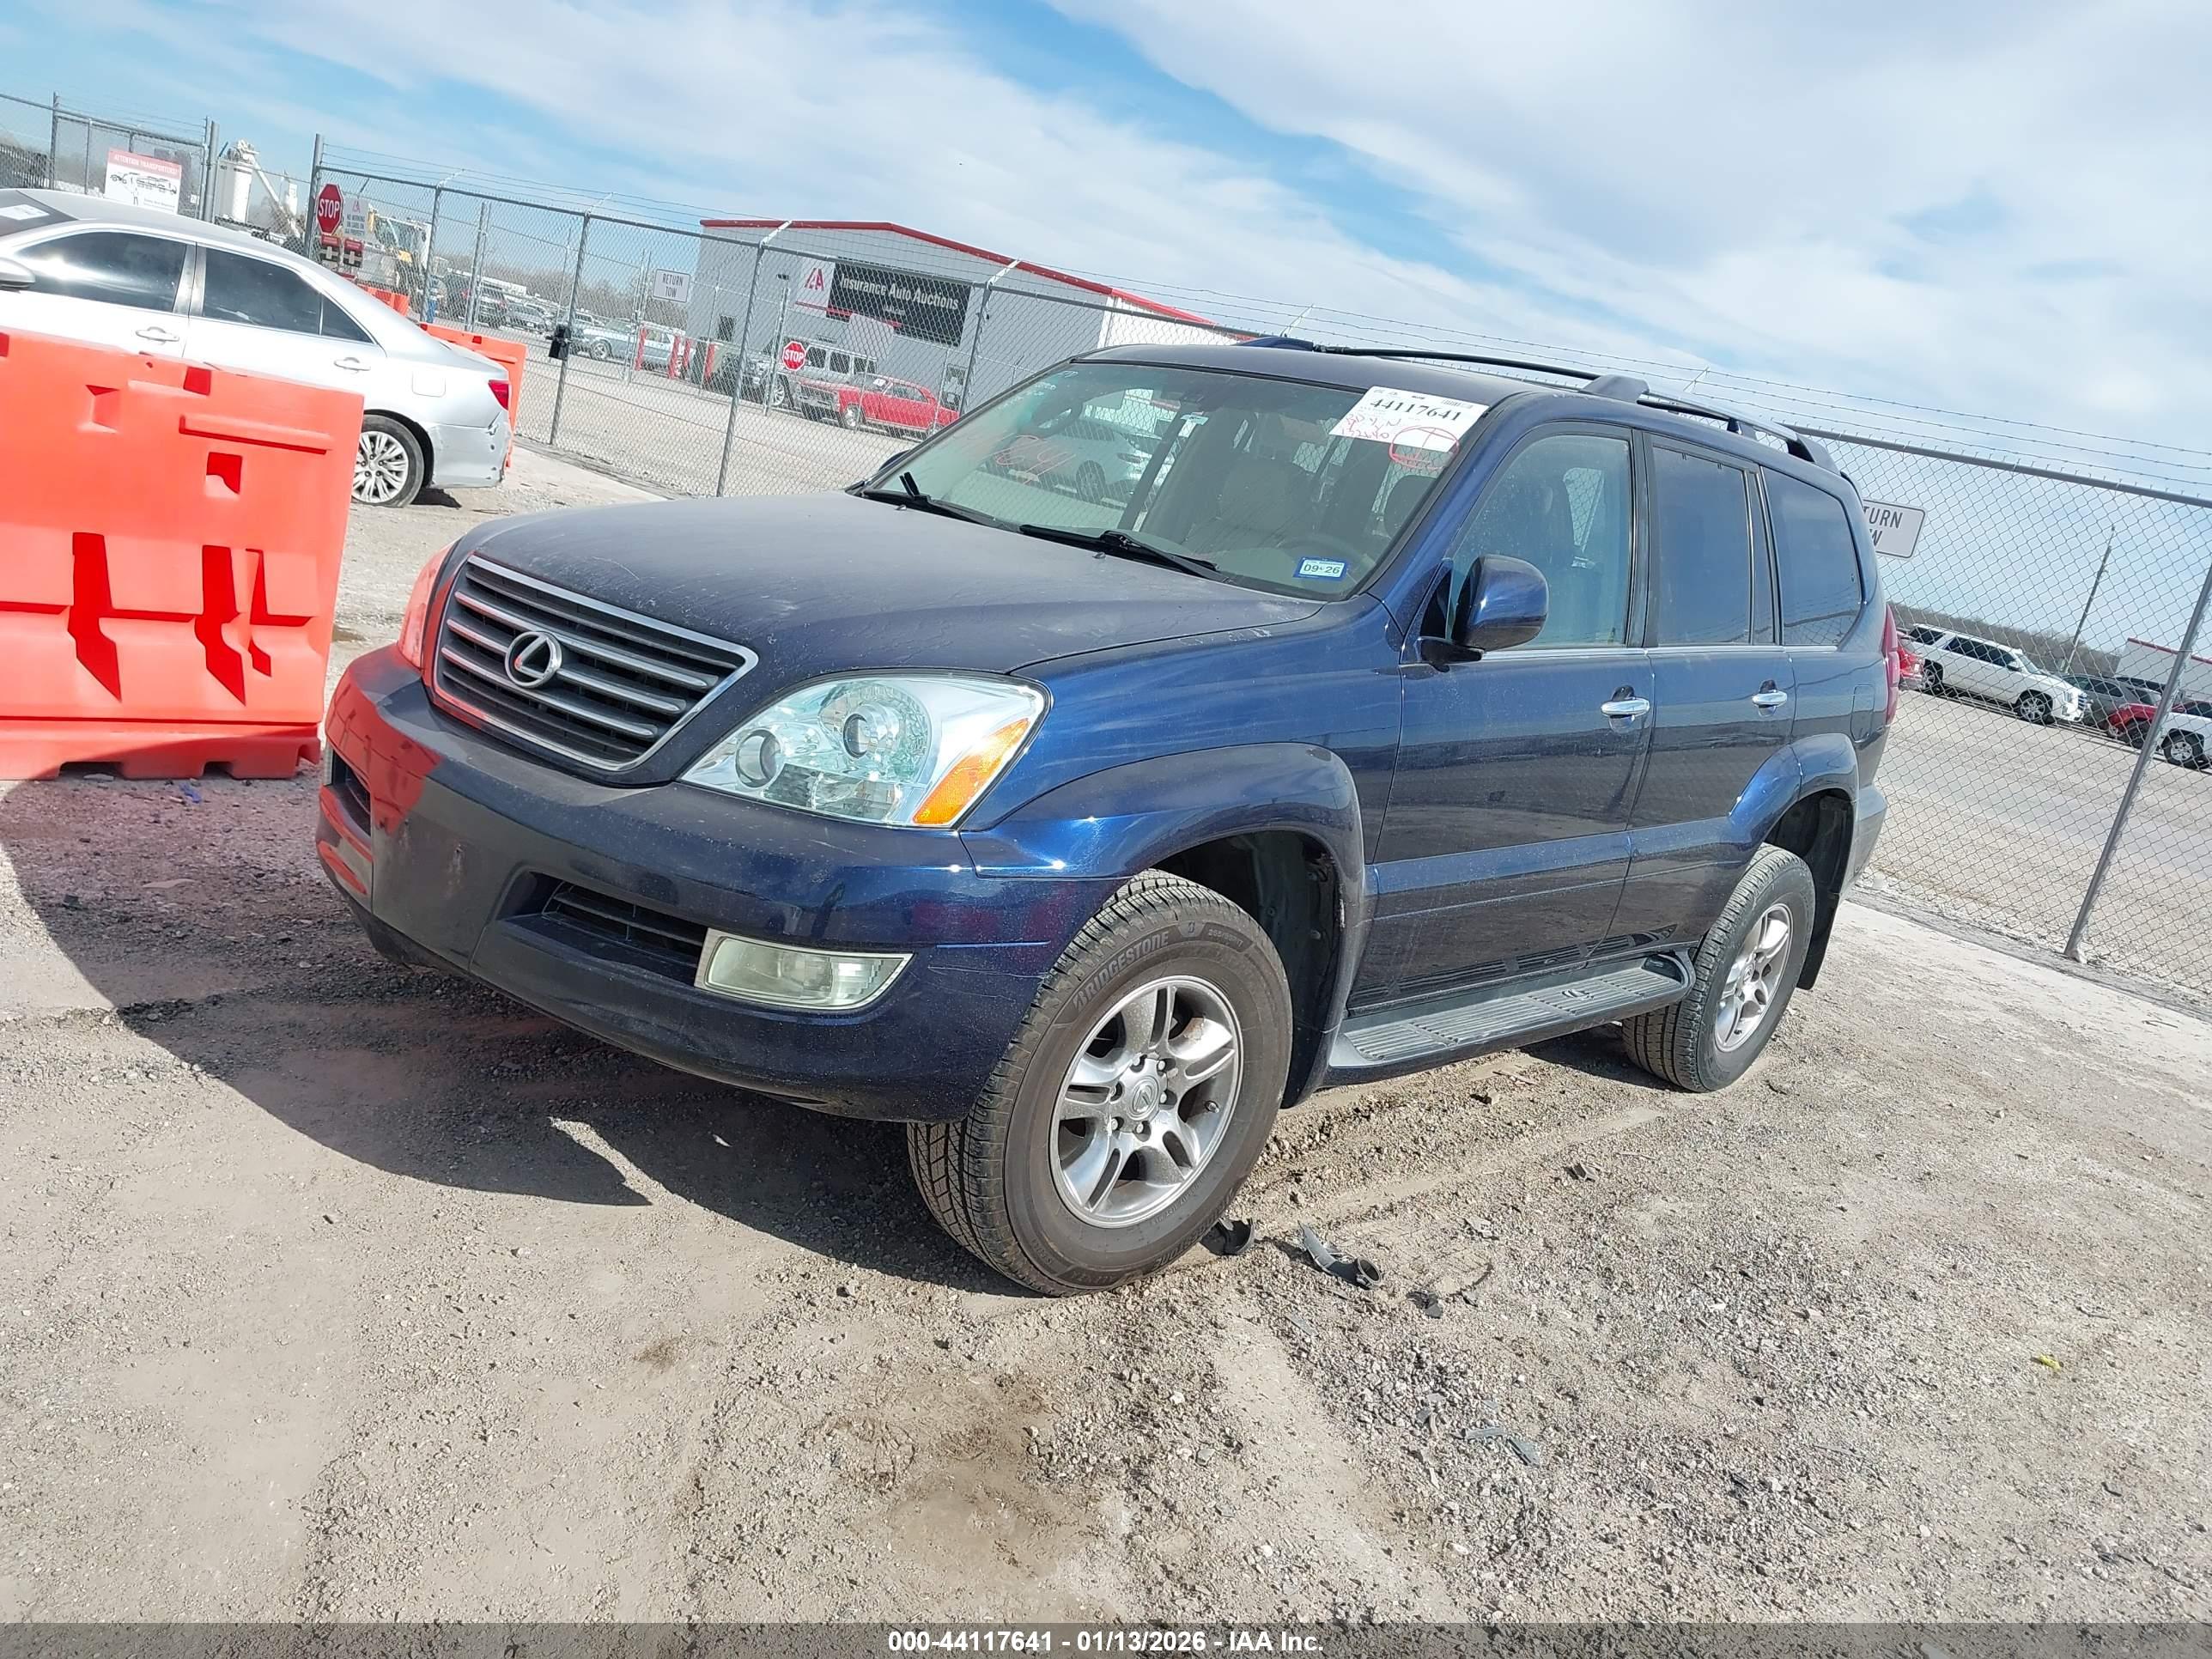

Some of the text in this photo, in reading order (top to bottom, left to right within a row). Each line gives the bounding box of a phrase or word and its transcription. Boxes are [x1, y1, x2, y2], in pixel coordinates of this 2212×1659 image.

[319, 198, 340, 219] STOP
[662, 273, 684, 287] RETURN
[665, 286, 678, 298] TOW
[840, 273, 887, 296] Insurance
[888, 282, 912, 301] Auto
[912, 290, 959, 311] Auctions
[784, 350, 804, 362] STOP
[1370, 398, 1462, 422] 44117641
[1304, 563, 1340, 574] 09 26
[1073, 931, 1170, 1011] BRIDGESTONE
